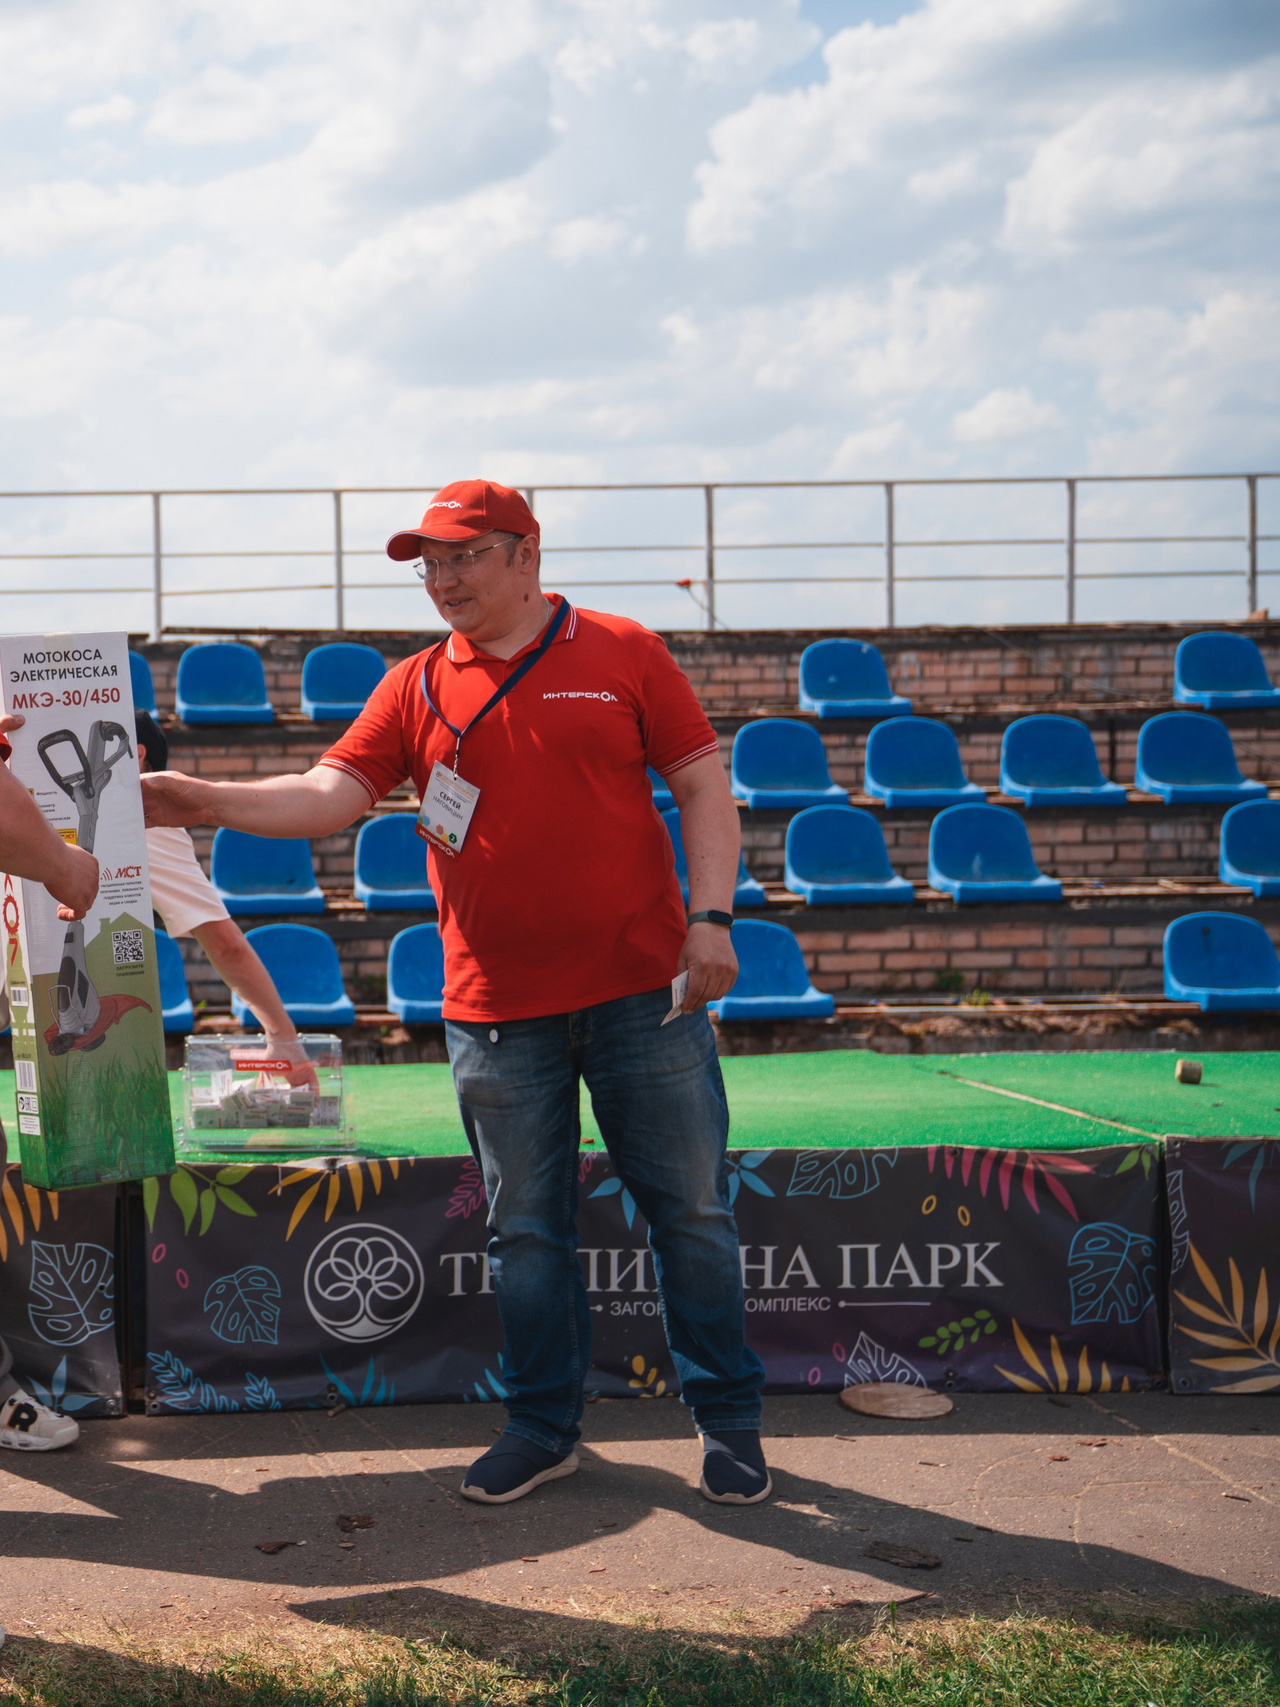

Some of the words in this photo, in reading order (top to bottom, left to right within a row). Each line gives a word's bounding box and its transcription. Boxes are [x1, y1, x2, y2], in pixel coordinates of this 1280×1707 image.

[23, 649, 102, 664] МОТОКОСА
[10, 665, 118, 683] ЭЛЕКТРИЧЕСКАЯ
[12, 687, 120, 709] МКЭ-30/450
[543, 691, 618, 702] ИНТЕРСКОЛ
[439, 791, 462, 811] СЕРГЕЙ
[419, 828, 455, 858] ИНТЕРСКОЛ
[238, 1061, 289, 1070] ИНТЕРСКОЛ
[837, 1242, 1004, 1289] ПАРК
[744, 1297, 832, 1313] ОМПЛЕКС
